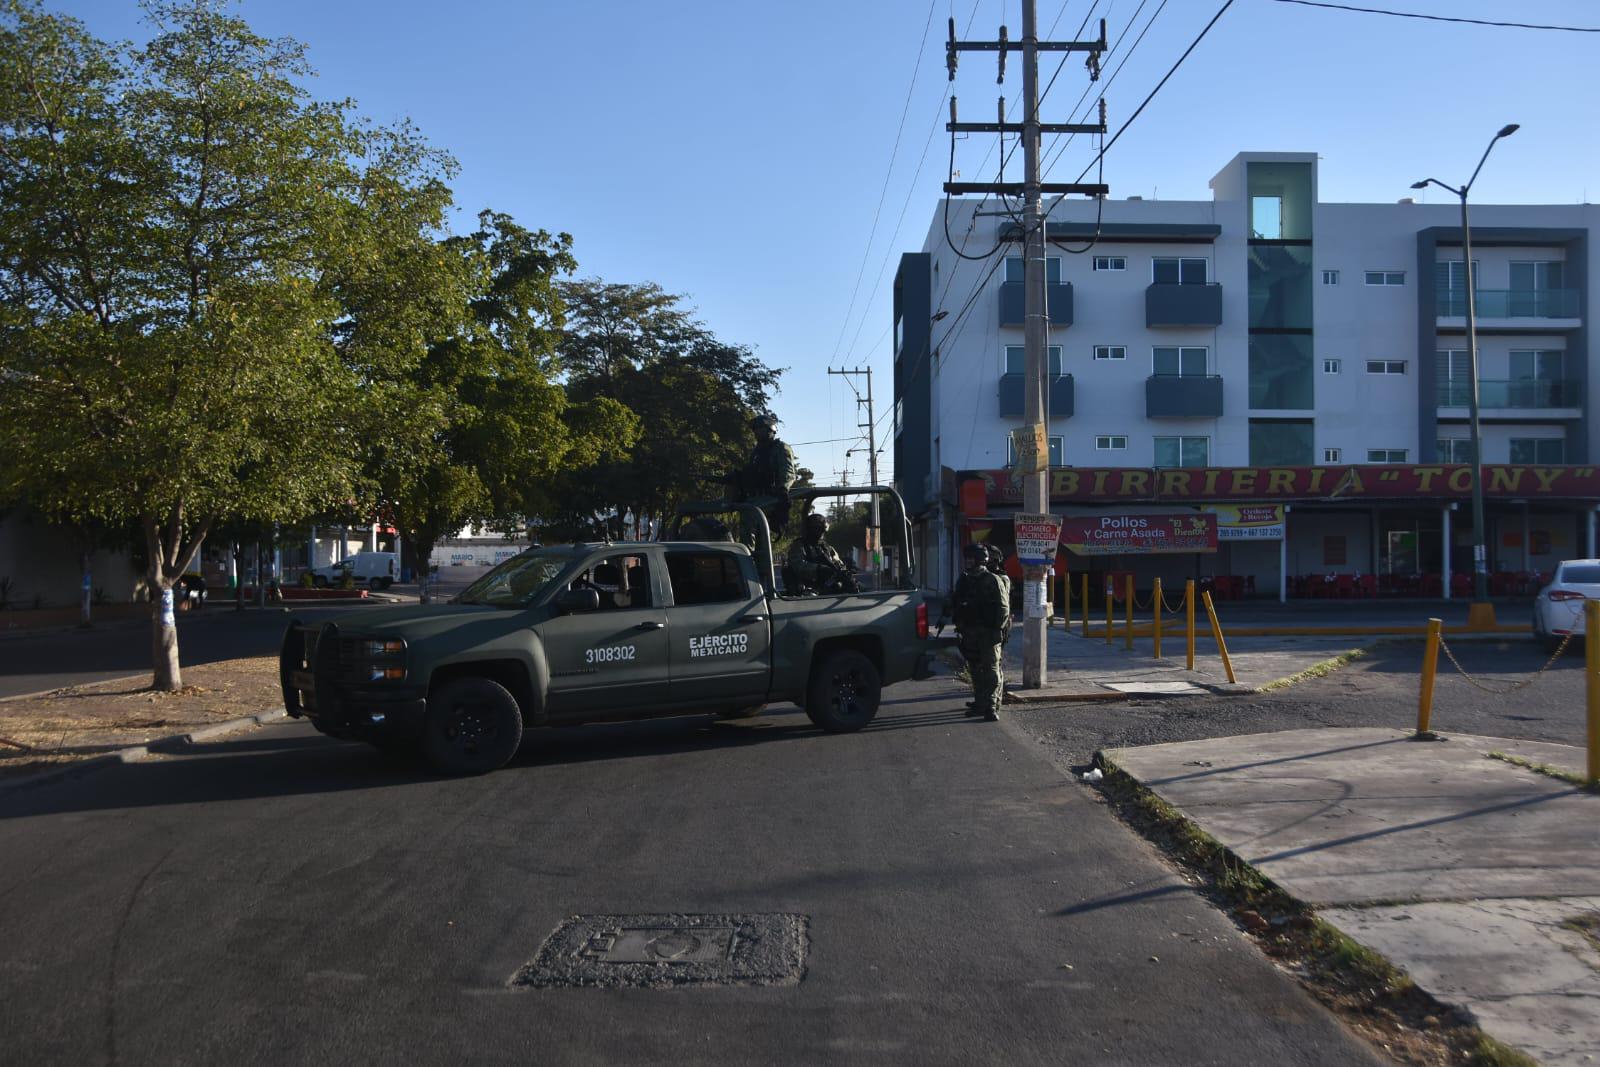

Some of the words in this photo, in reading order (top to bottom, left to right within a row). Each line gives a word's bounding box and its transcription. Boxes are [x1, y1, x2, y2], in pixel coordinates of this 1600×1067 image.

[1051, 469, 1366, 497] BIRRIERIA
[1101, 516, 1148, 529] Pollos
[1084, 529, 1092, 539] Y
[1094, 529, 1128, 539] Carne
[1131, 528, 1166, 538] Asada
[689, 633, 748, 649] EJÉRCITO
[585, 645, 636, 664] 3108302
[690, 644, 747, 657] MEXICANO
